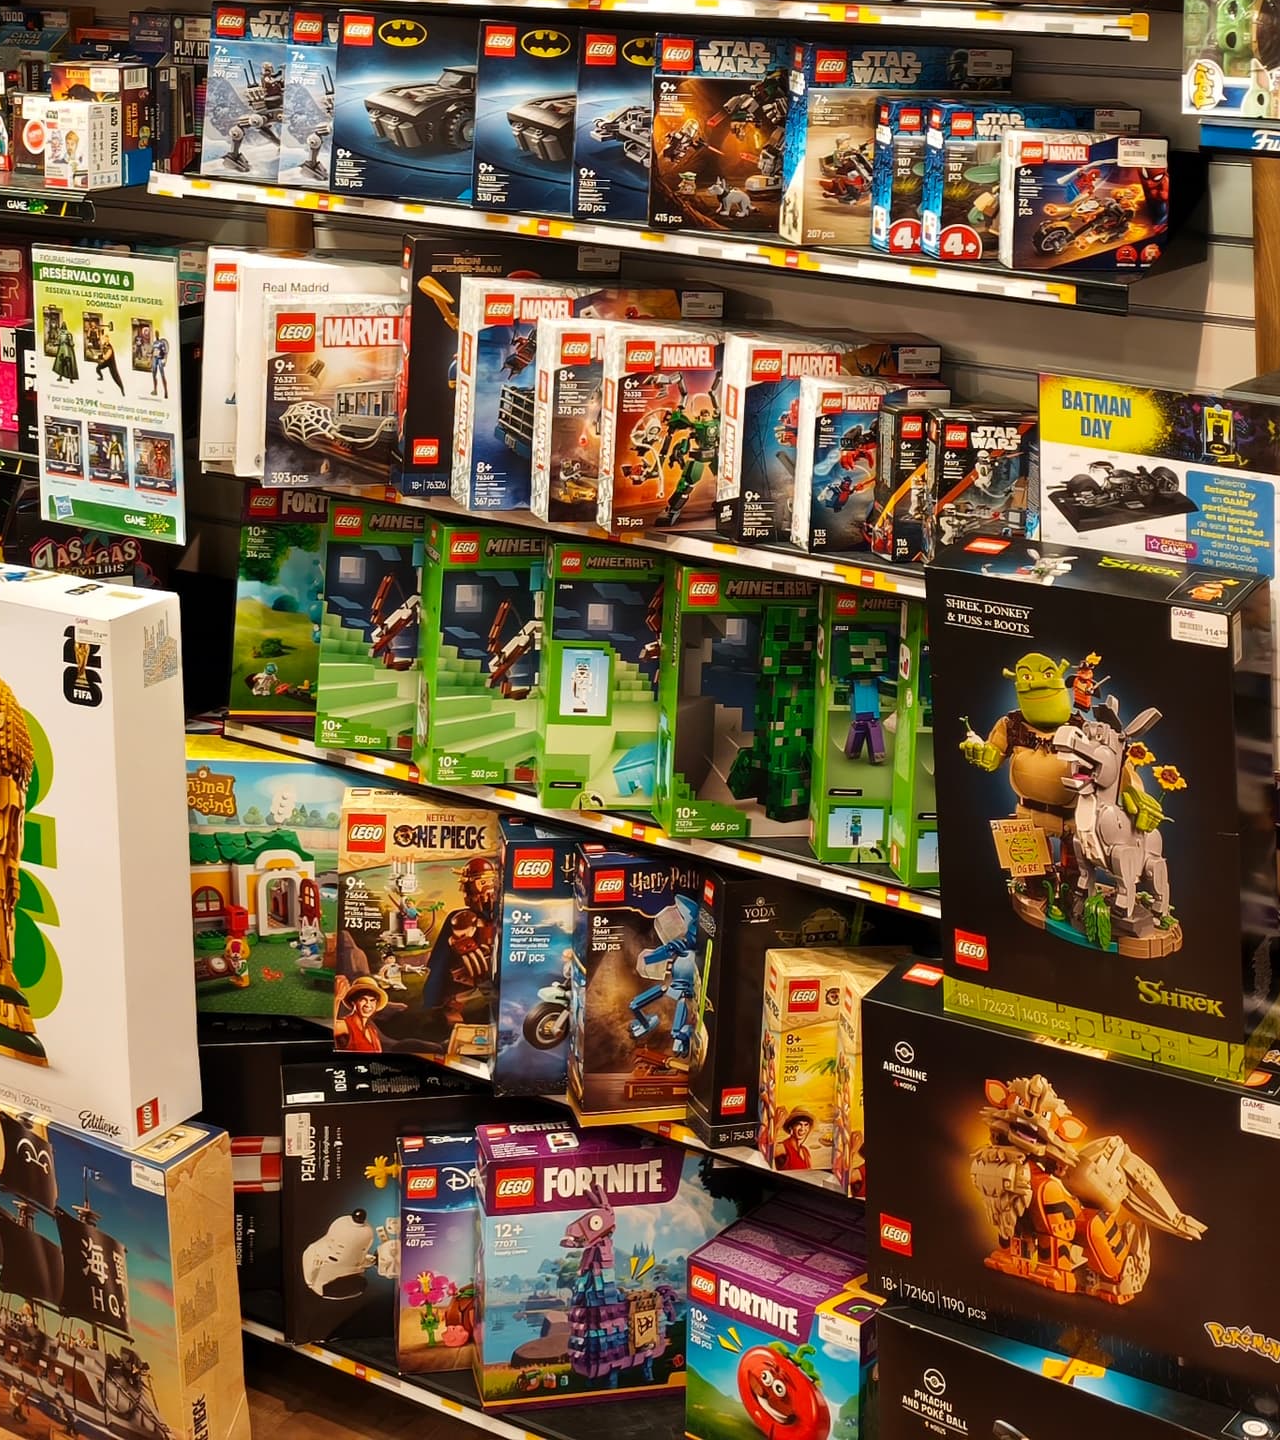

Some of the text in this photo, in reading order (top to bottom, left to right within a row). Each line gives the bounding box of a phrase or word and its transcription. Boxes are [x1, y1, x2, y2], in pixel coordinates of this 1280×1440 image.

[1047, 144, 1087, 163] MARVEL
[39, 266, 120, 285] ¡RESÉRVALO YA!
[262, 282, 329, 294] Real Madrid
[86, 299, 122, 309] DOOMSDAY
[276, 315, 399, 347] LEGO MARVEL
[1062, 389, 1132, 418] BATMAN
[1080, 416, 1112, 440] DAY
[586, 554, 656, 570] MINECRAFT
[946, 598, 1030, 619] SHREK, DONKEY
[947, 612, 956, 621] &
[958, 613, 983, 626] PUSS
[994, 619, 1030, 633] BOOTS
[73, 687, 93, 701] FIFA
[426, 814, 455, 822] NETFLIX
[744, 905, 776, 919] YODA
[883, 1060, 928, 1083] ARCANINE
[78, 1110, 121, 1138] Editions
[497, 1159, 665, 1202] LEGO FORTNITE
[914, 1389, 953, 1413] PIKACHU
[902, 1395, 920, 1409] AND
[946, 1411, 969, 1431] BALL
